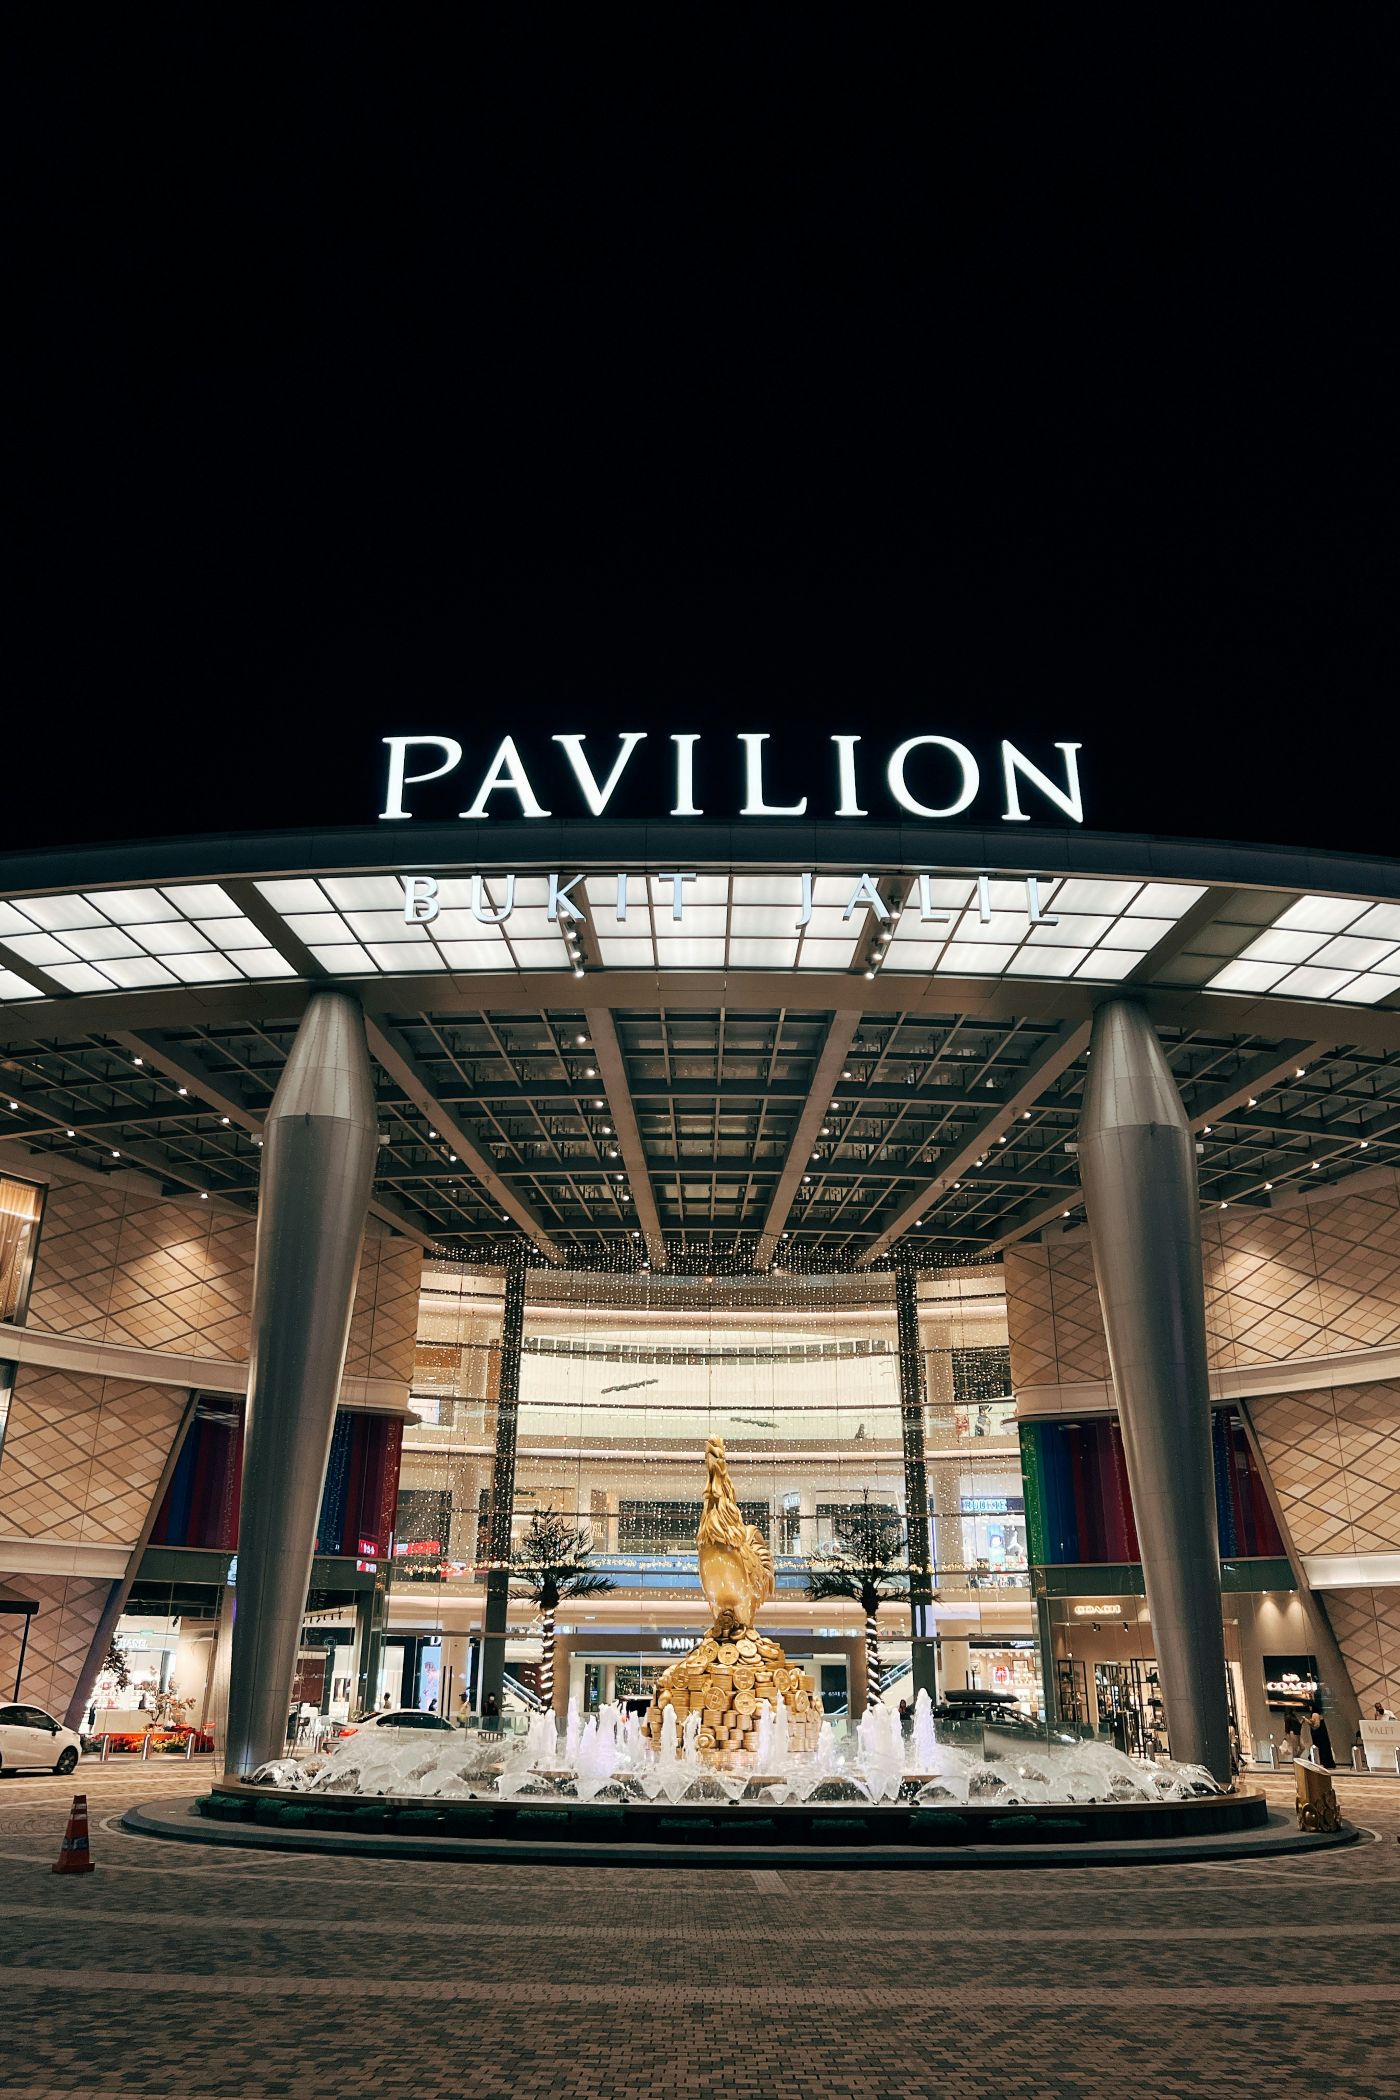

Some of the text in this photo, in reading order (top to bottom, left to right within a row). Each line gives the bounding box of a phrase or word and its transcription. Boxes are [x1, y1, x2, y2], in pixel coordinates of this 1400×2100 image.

[378, 732, 1084, 823] PAVILION
[403, 872, 1060, 928] BUKIT JALIL
[1074, 1604, 1122, 1616] COACH
[661, 1637, 695, 1650] MAIN
[1266, 1681, 1318, 1692] COACH
